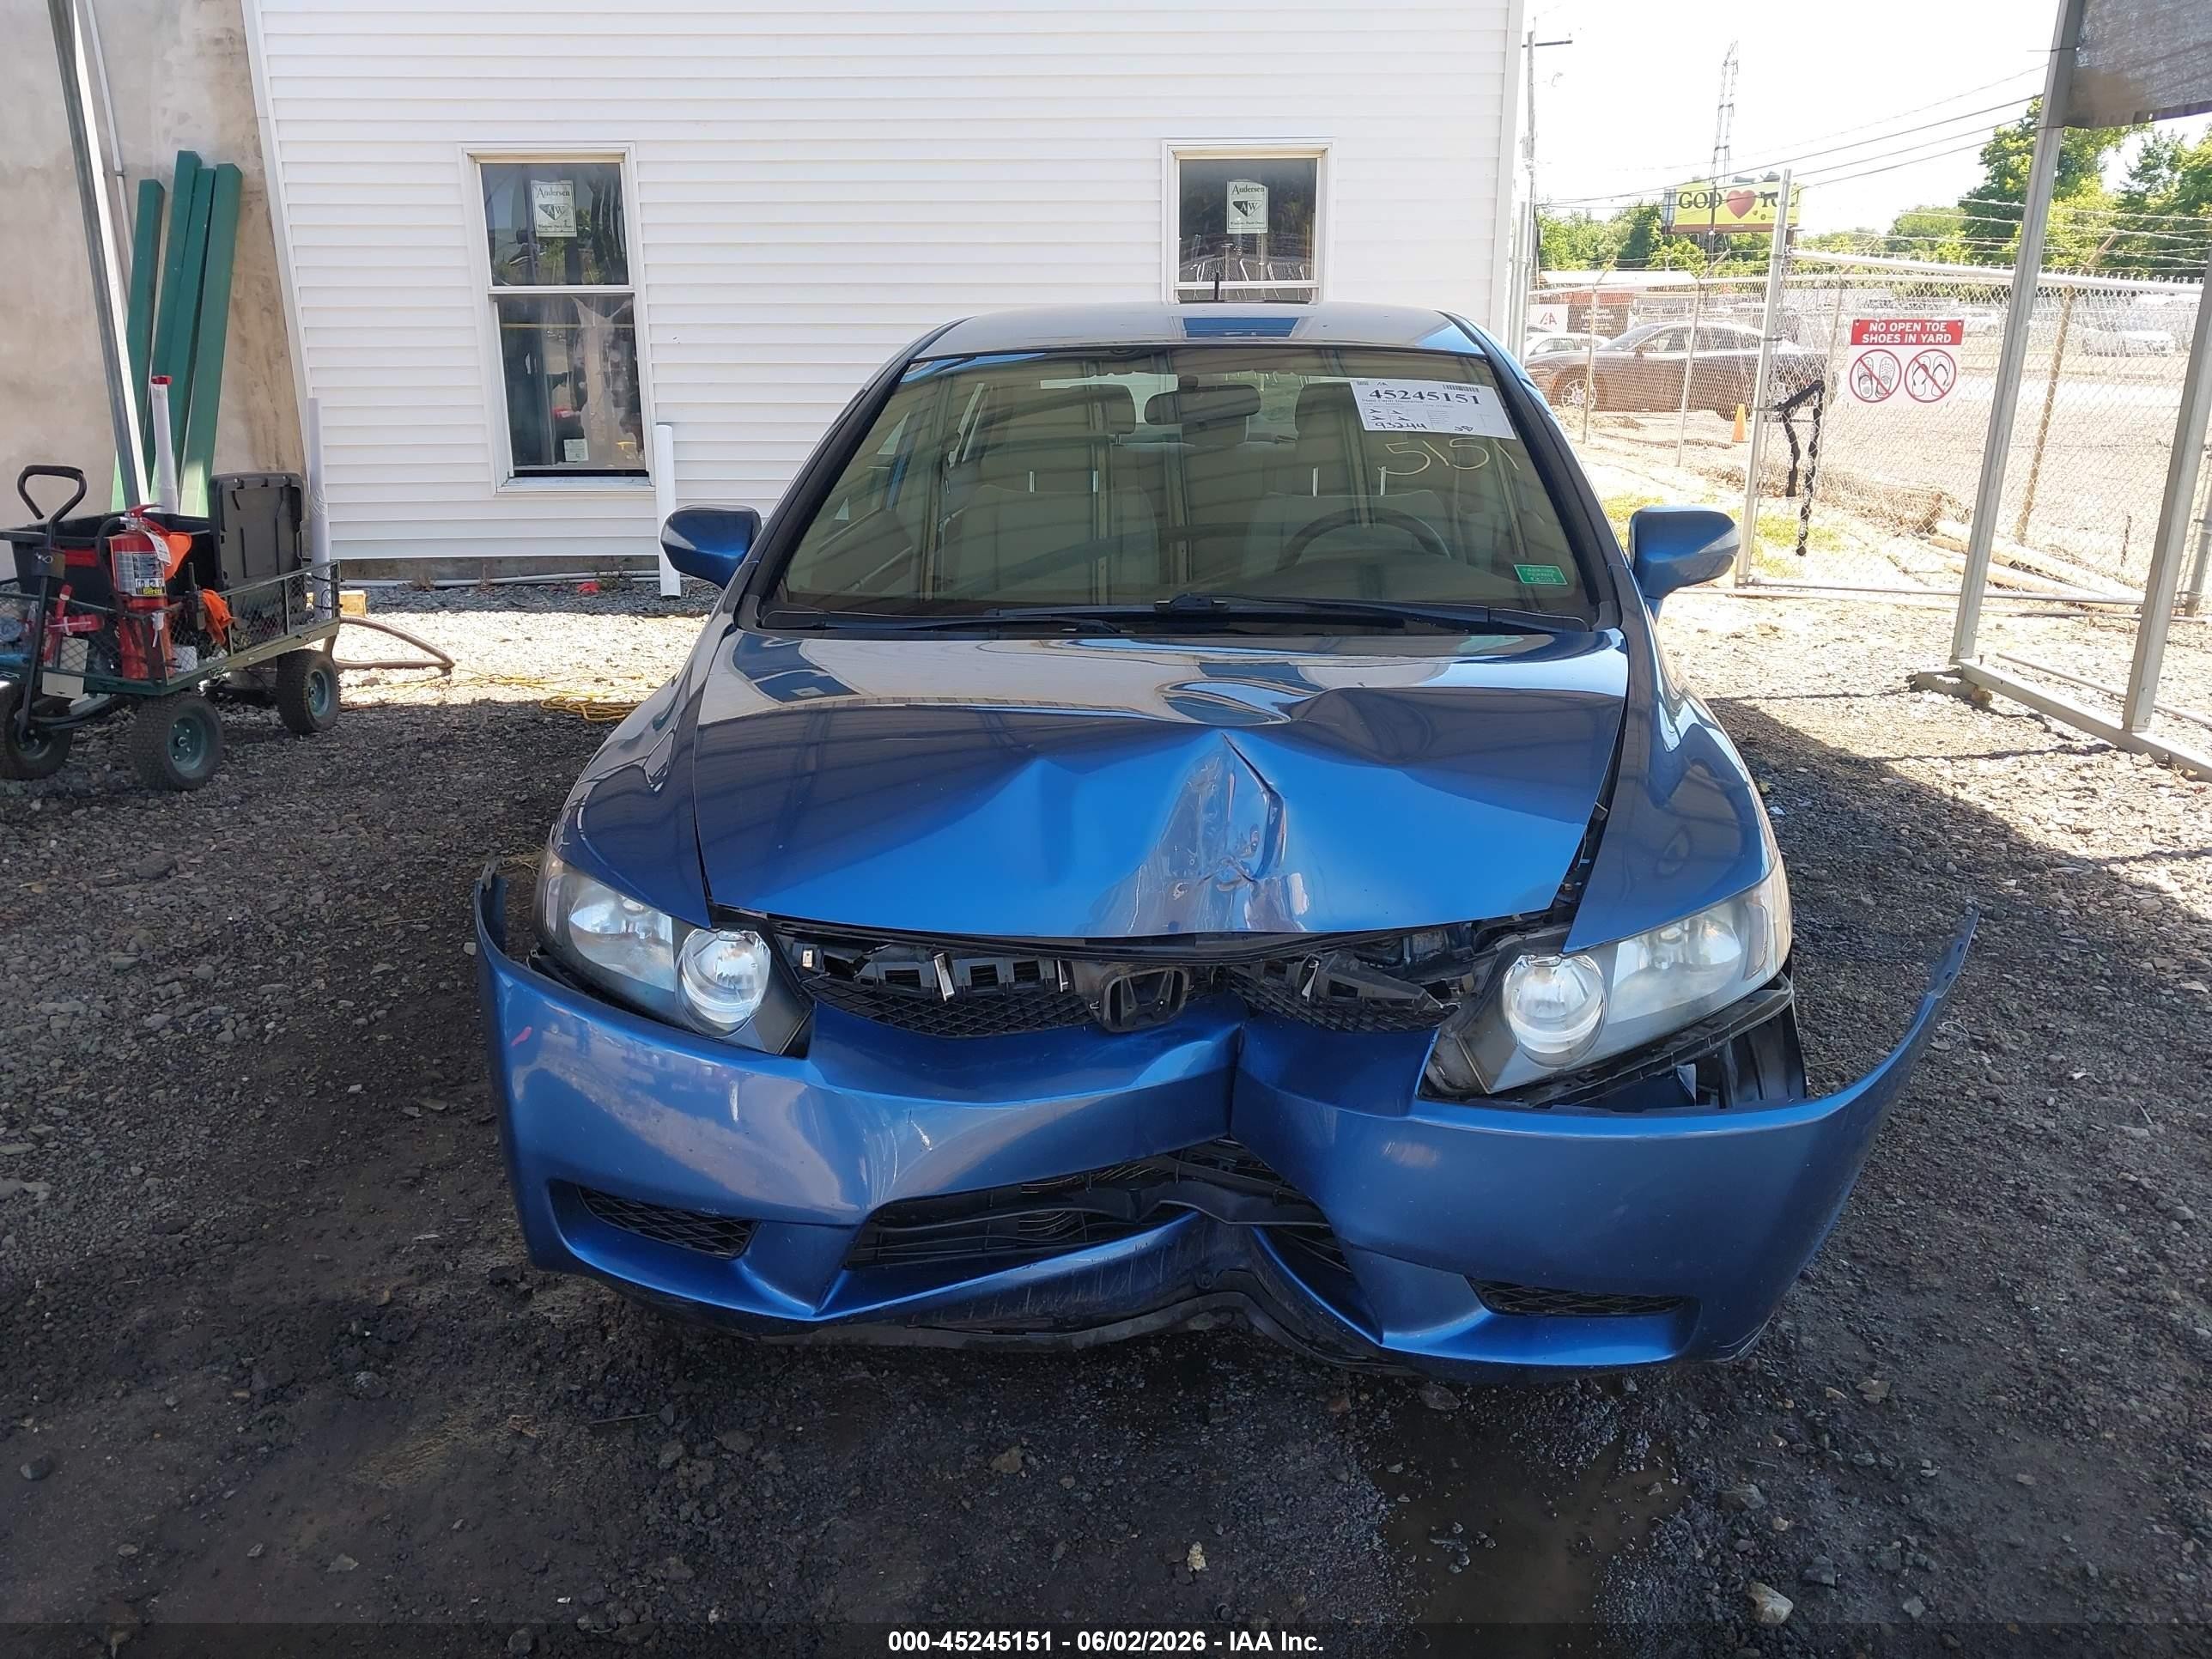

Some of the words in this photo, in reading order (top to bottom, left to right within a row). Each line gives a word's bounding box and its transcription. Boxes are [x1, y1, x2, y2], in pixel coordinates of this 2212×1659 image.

[537, 187, 571, 198] Andersen
[1231, 185, 1265, 194] Andersen
[1679, 191, 1723, 209] GOD
[1869, 322, 1886, 332] NO
[1889, 322, 1921, 332] OPEN
[1925, 322, 1948, 332] TOE
[1862, 333, 1900, 343] SHOES
[1905, 333, 1917, 343] IN
[1921, 333, 1952, 343] YARD
[1369, 389, 1482, 405] 45245151
[1377, 437, 1520, 476] 5151
